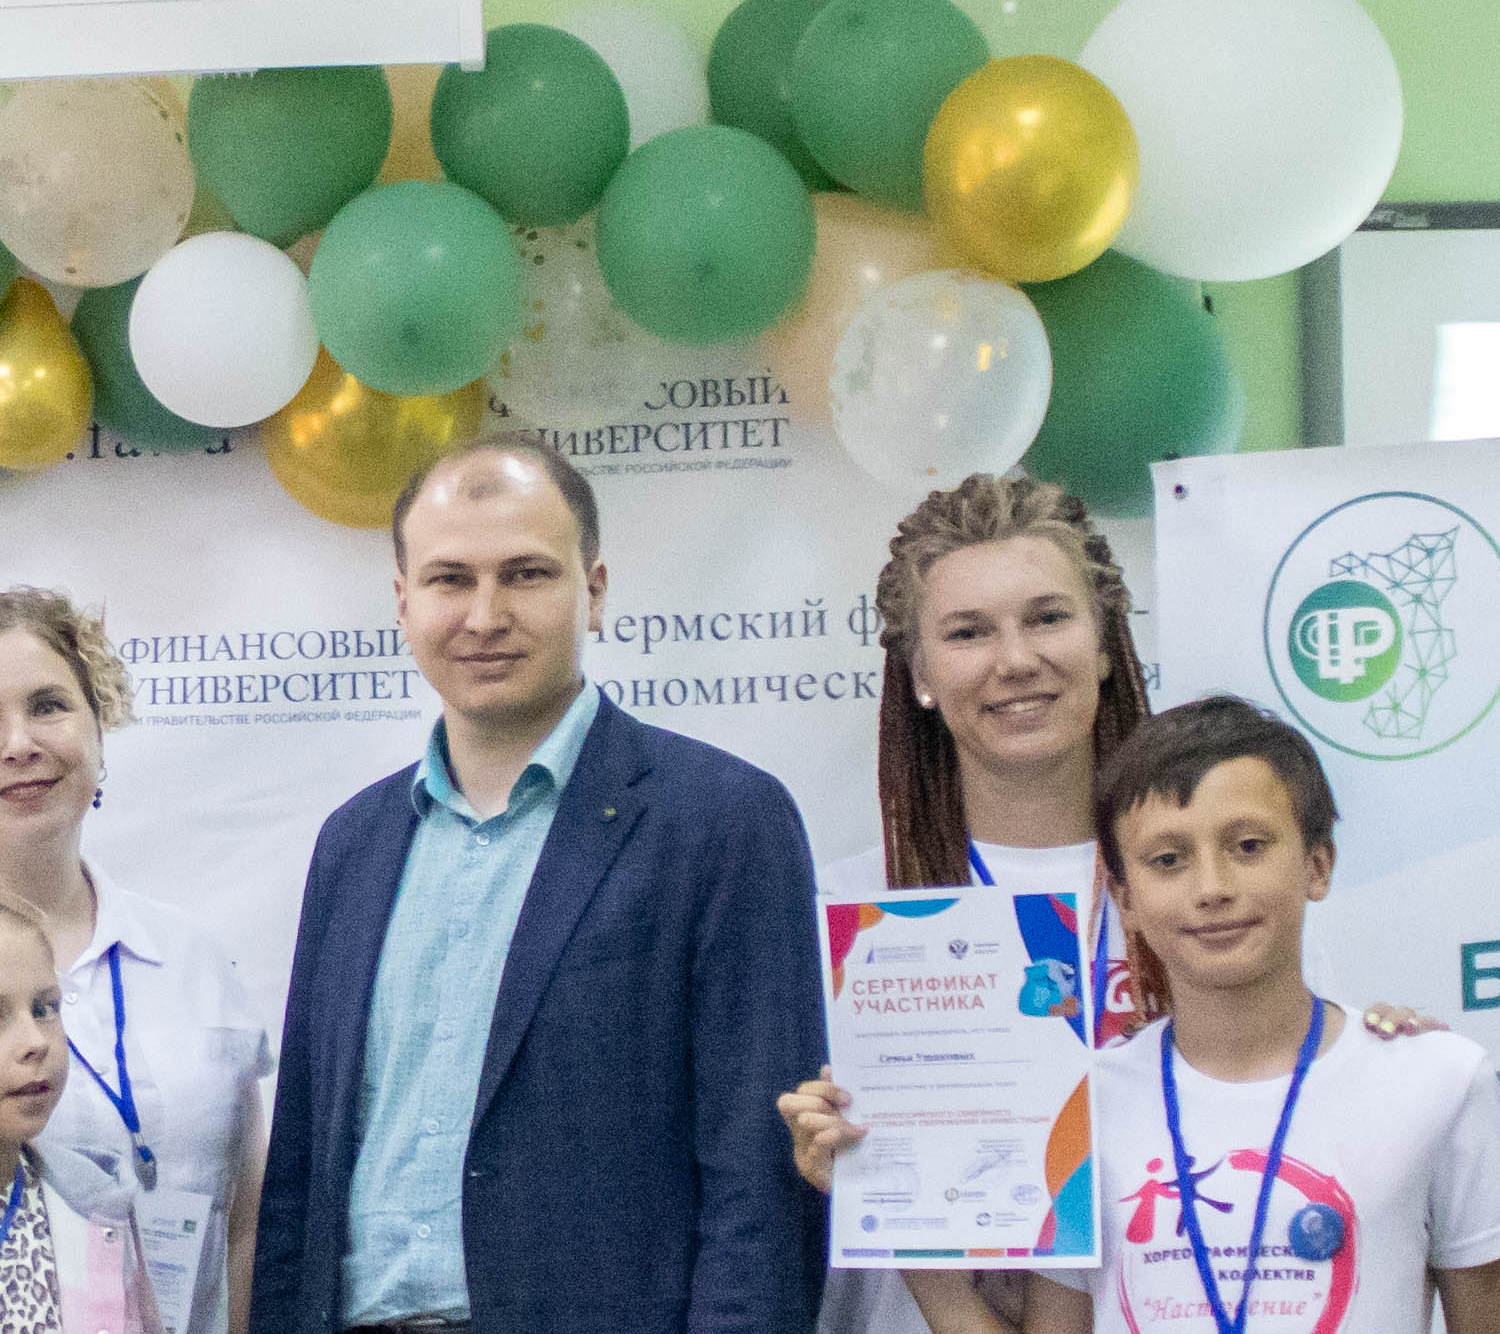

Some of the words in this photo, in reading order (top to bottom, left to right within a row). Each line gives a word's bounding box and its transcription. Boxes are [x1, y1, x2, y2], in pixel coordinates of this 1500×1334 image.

[594, 597, 828, 655] ермский
[603, 671, 881, 707] ономическ
[851, 972, 998, 996] СЕРТИФИКАТ
[853, 994, 985, 1015] УЧАСТНИКА
